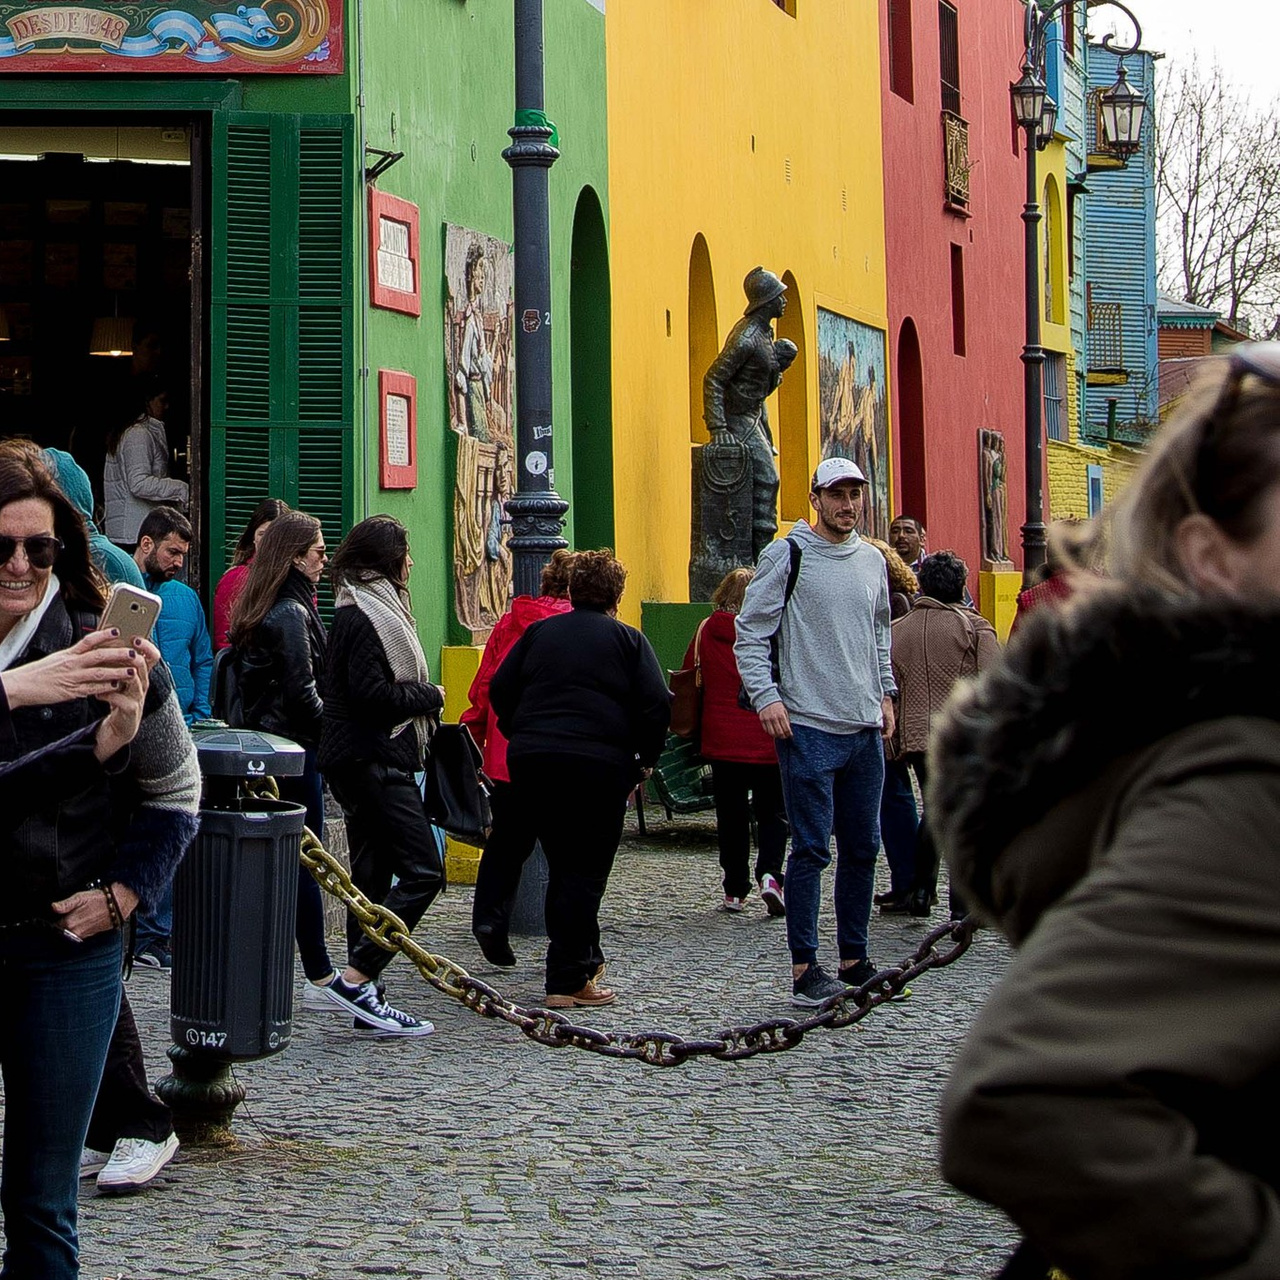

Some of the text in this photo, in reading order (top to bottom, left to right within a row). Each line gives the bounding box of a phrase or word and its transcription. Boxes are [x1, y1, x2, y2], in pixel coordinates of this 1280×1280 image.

[13, 12, 125, 41] DESDE 1948
[200, 1031, 228, 1048] 147
